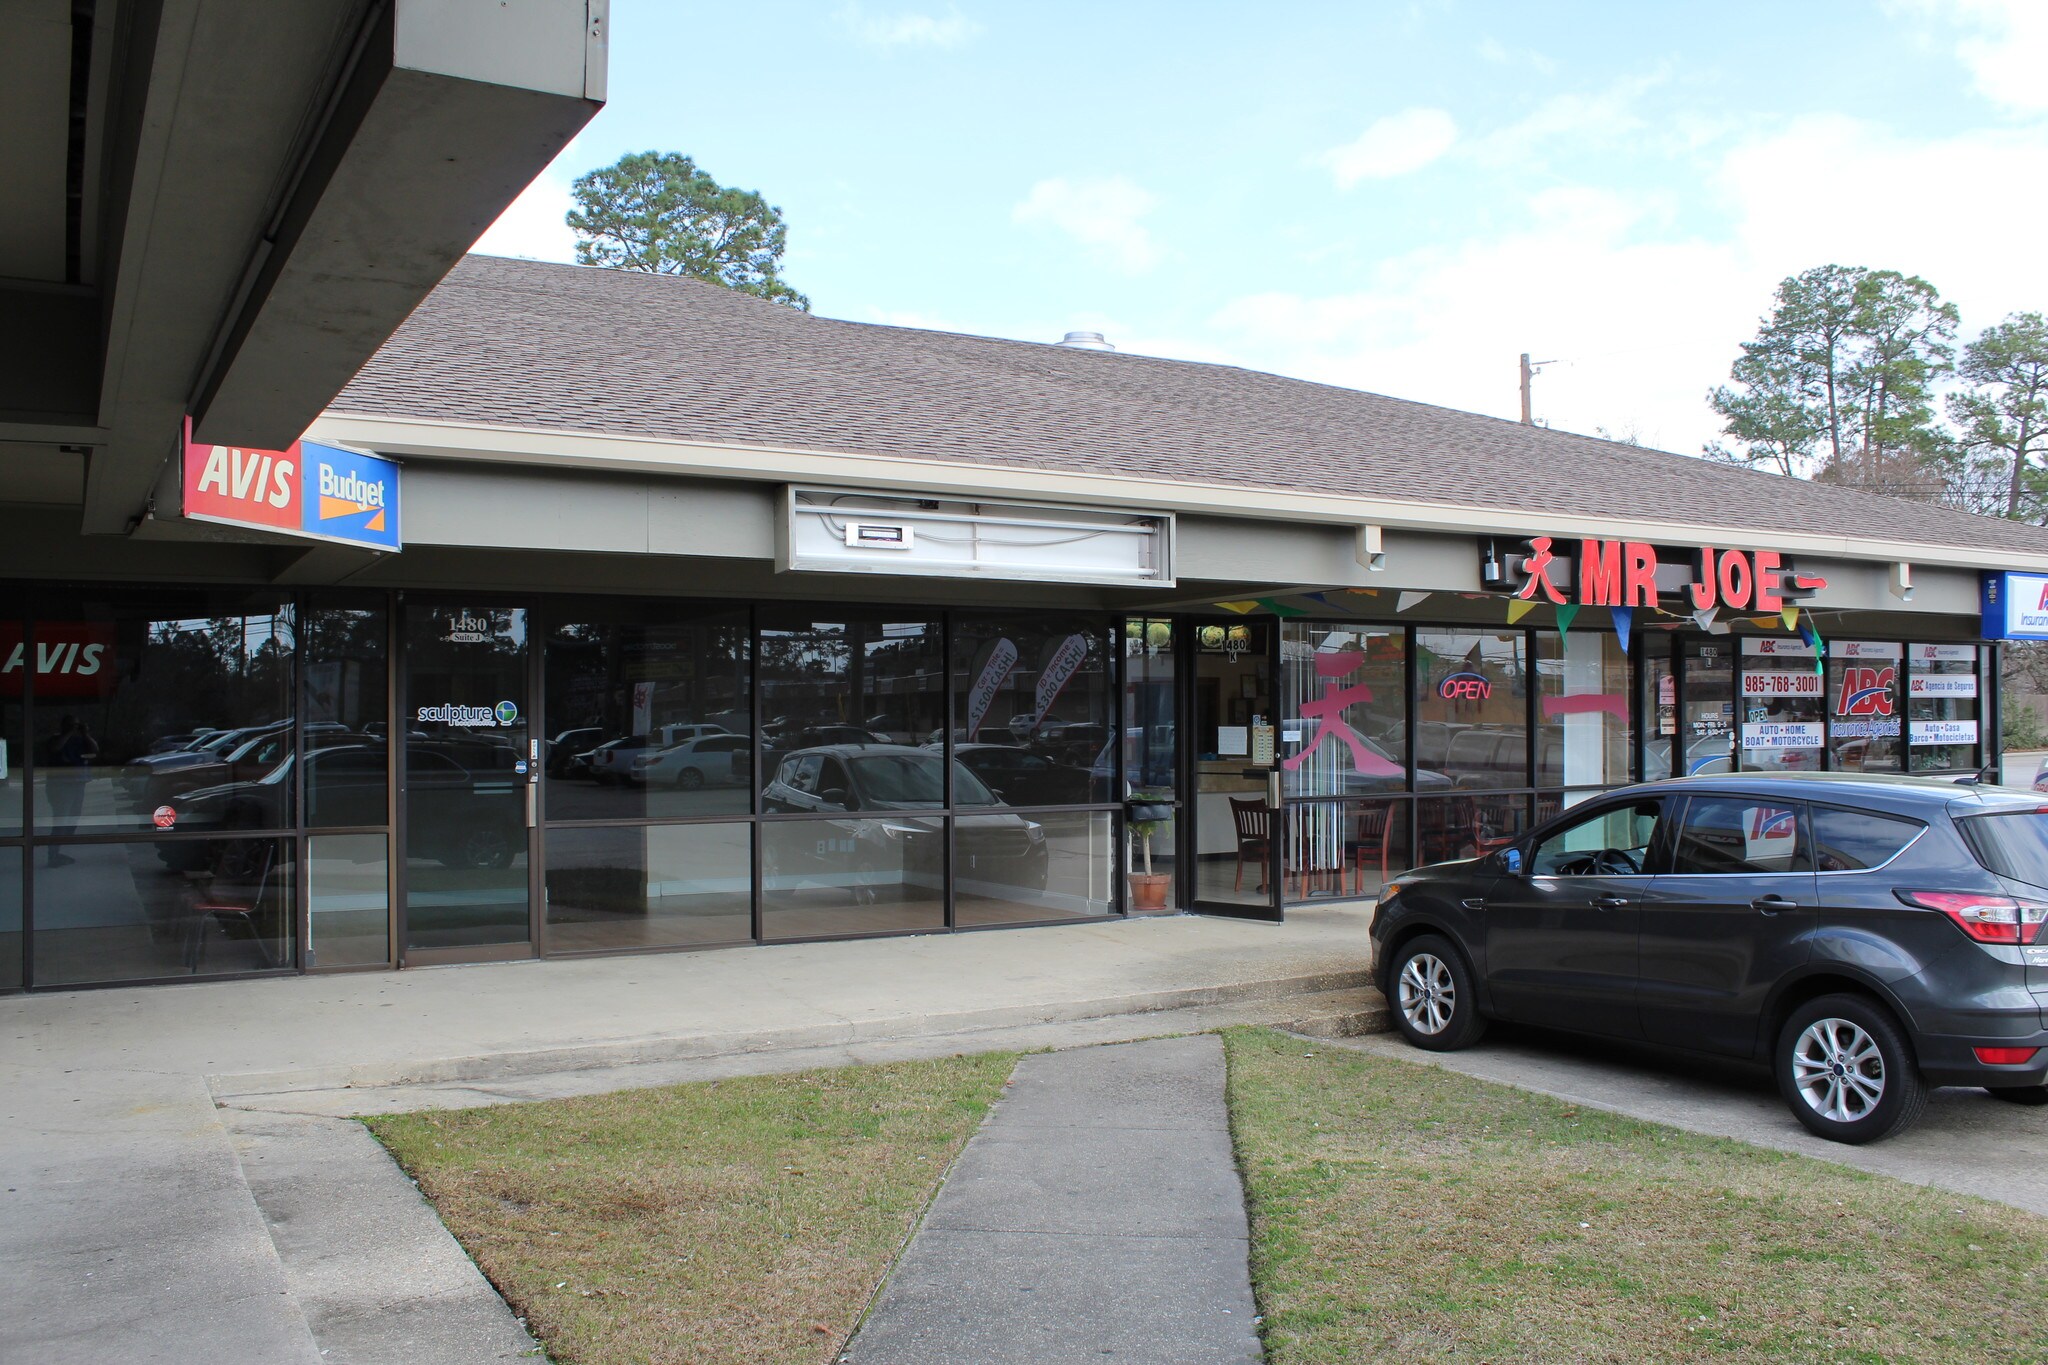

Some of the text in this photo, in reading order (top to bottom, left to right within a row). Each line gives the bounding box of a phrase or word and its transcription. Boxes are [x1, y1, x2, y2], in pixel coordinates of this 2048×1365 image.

[197, 445, 294, 509] AVIS
[319, 462, 385, 511] Budget
[1580, 538, 1783, 612] MR JOE
[449, 617, 487, 632] 1480
[454, 633, 481, 642] Suite J
[1222, 639, 1247, 651] 1480
[1760, 640, 1776, 653] ABC
[1, 642, 105, 675] AVIS
[987, 652, 1003, 670] Title
[1048, 643, 1071, 673] Income
[1229, 651, 1237, 662] K
[971, 651, 1015, 720] $1500 CASH!
[1036, 644, 1084, 713] $300 CASH!
[1745, 675, 1818, 693] 985-768-3001
[1910, 679, 1974, 692] ABC Agencia de Seguros
[1443, 680, 1492, 699] OPEN
[1836, 667, 1895, 716] ABC
[418, 703, 493, 727] sculpture
[1701, 712, 1719, 720] HOURS
[1749, 708, 1768, 722] OPEN
[1760, 725, 1806, 735] AUTO HOME
[1830, 717, 1901, 740] Insurance Agencies
[1924, 723, 1960, 732] Auto Casa
[1745, 735, 1819, 746] BOAT MOTORCYCLE
[1909, 732, 1975, 742] Barco Motocicletas
